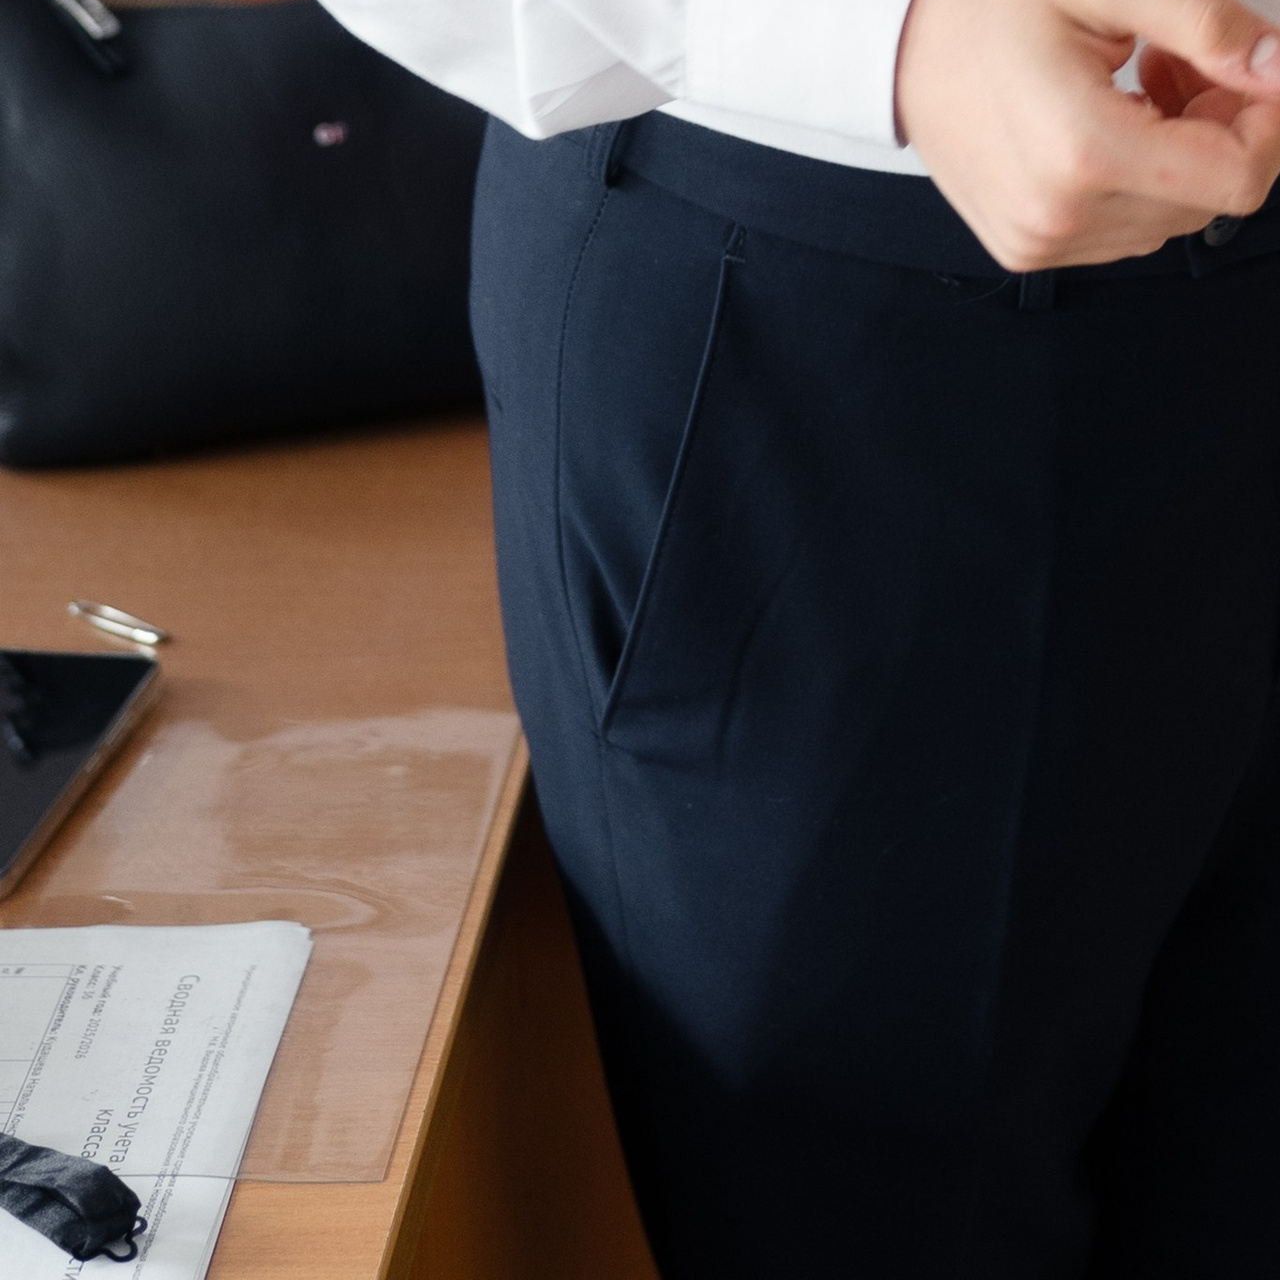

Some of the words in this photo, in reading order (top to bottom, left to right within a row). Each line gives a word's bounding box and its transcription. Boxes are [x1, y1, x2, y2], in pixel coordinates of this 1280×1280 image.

[159, 974, 200, 1036] Сводная
[16, 1078, 40, 1111] Наталья
[127, 1039, 171, 1119] ведомость
[82, 1108, 114, 1159] класса
[109, 1121, 140, 1164] учета
